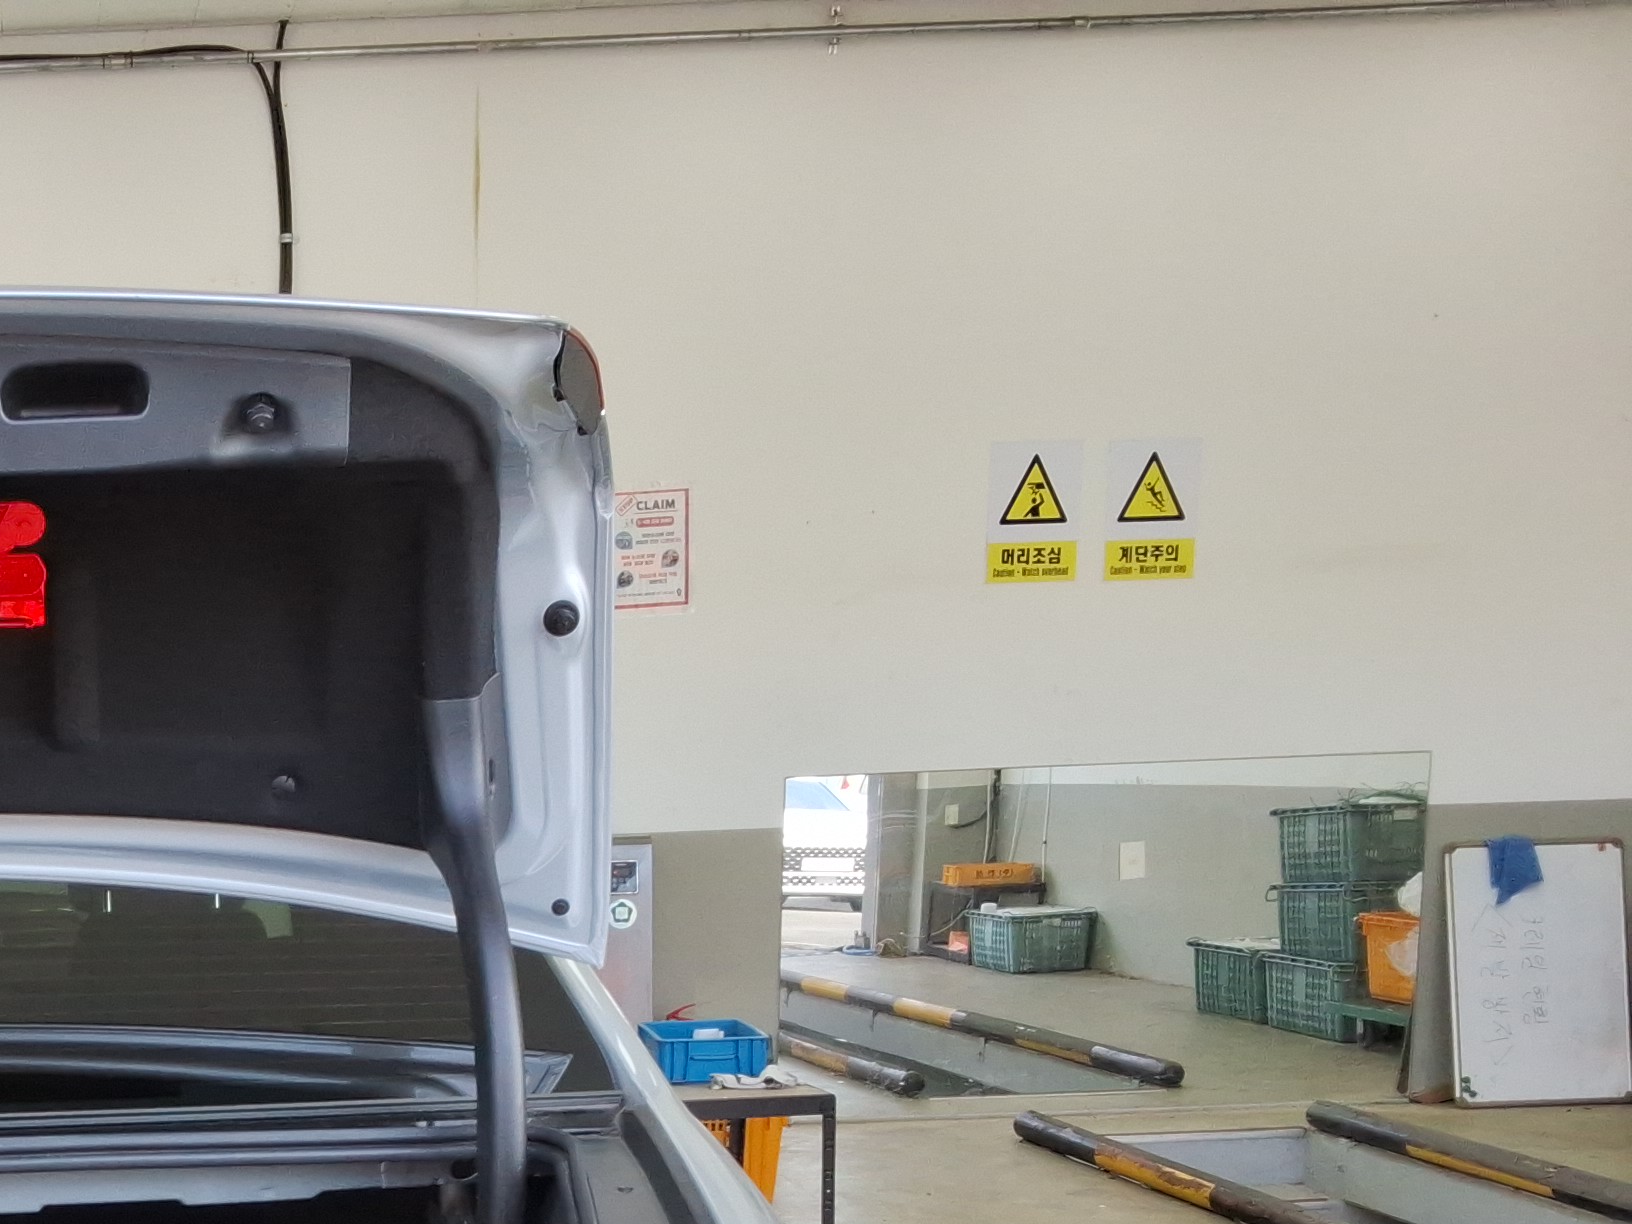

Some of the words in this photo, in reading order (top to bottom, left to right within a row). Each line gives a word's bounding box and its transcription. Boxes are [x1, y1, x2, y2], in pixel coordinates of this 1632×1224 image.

[636, 499, 676, 511] CLAIM
[1001, 547, 1061, 565] 머리조심
[1119, 544, 1179, 563] 계단주의
